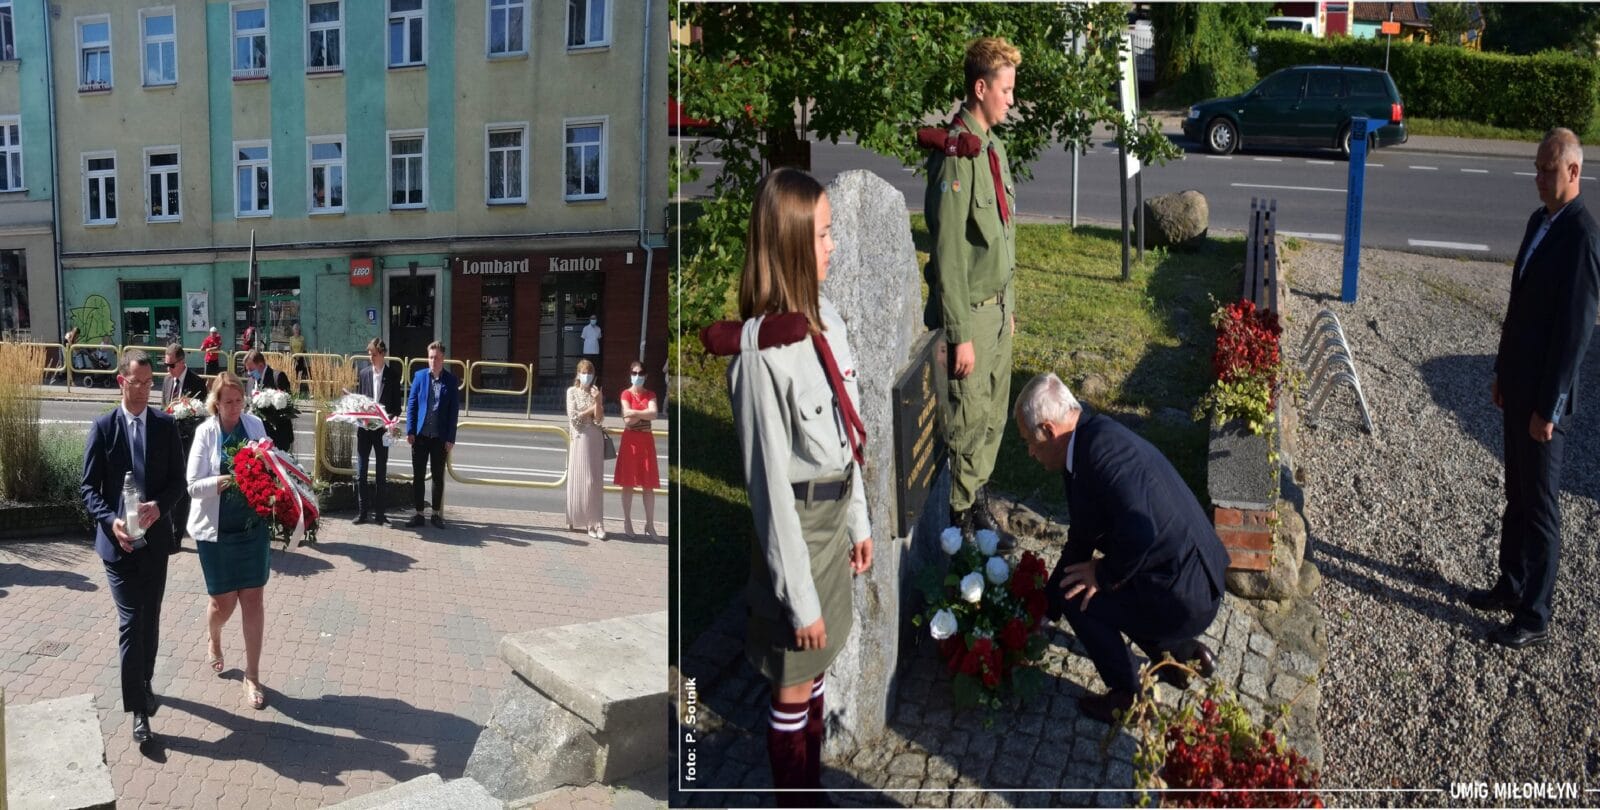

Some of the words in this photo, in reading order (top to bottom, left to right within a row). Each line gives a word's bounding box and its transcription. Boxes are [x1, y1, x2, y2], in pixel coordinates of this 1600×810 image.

[352, 267, 370, 276] LEGO
[462, 258, 530, 275] Lombard
[549, 256, 602, 272] Kantor
